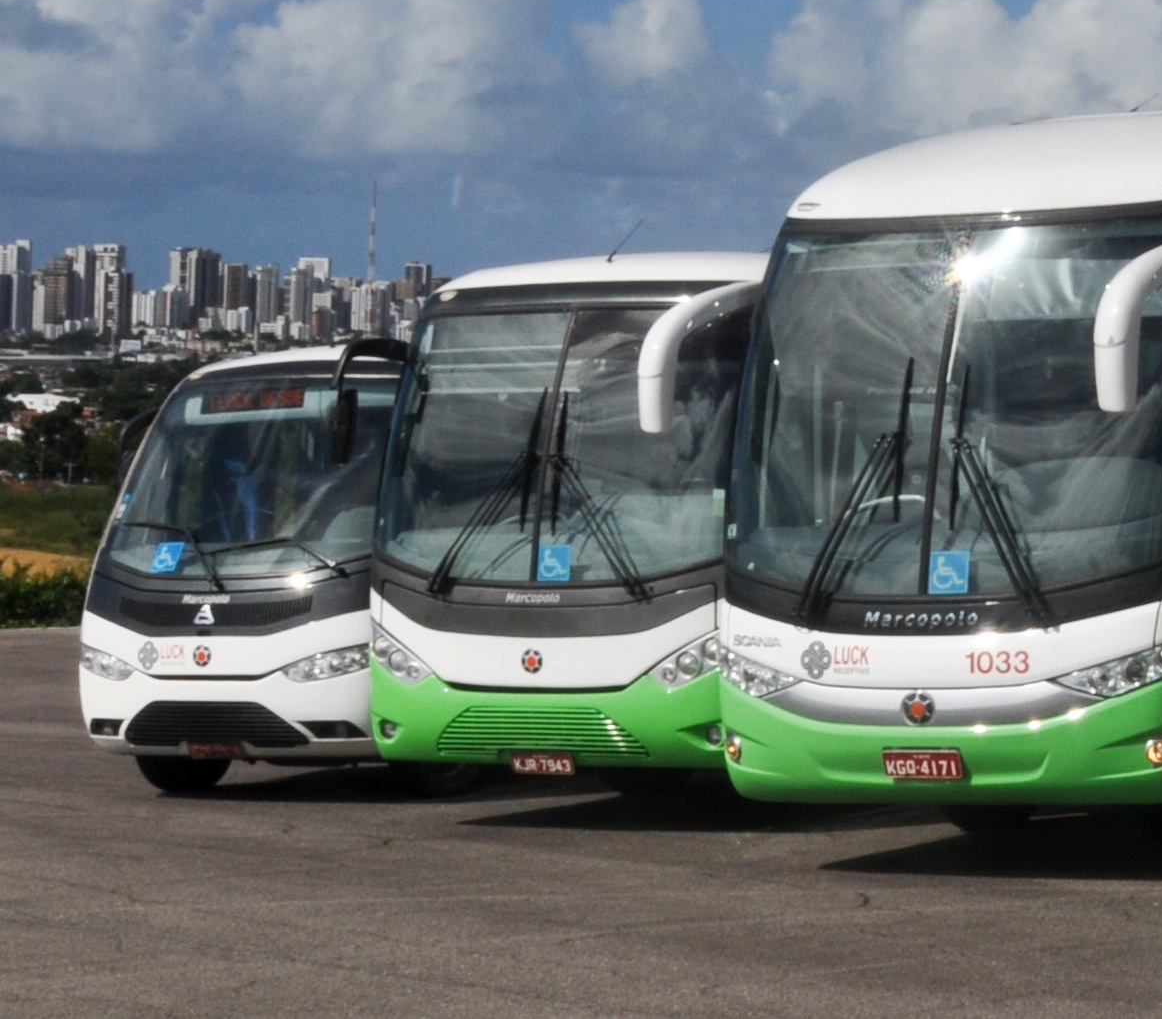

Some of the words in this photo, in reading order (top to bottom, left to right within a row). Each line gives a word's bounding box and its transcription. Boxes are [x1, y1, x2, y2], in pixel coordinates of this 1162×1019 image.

[505, 592, 560, 603] Marcopolo
[864, 610, 979, 628] Marcopolo
[733, 634, 782, 647] SCANIA
[160, 644, 186, 659] LUCK
[833, 645, 869, 665] LUCK
[965, 650, 1030, 674] 1033
